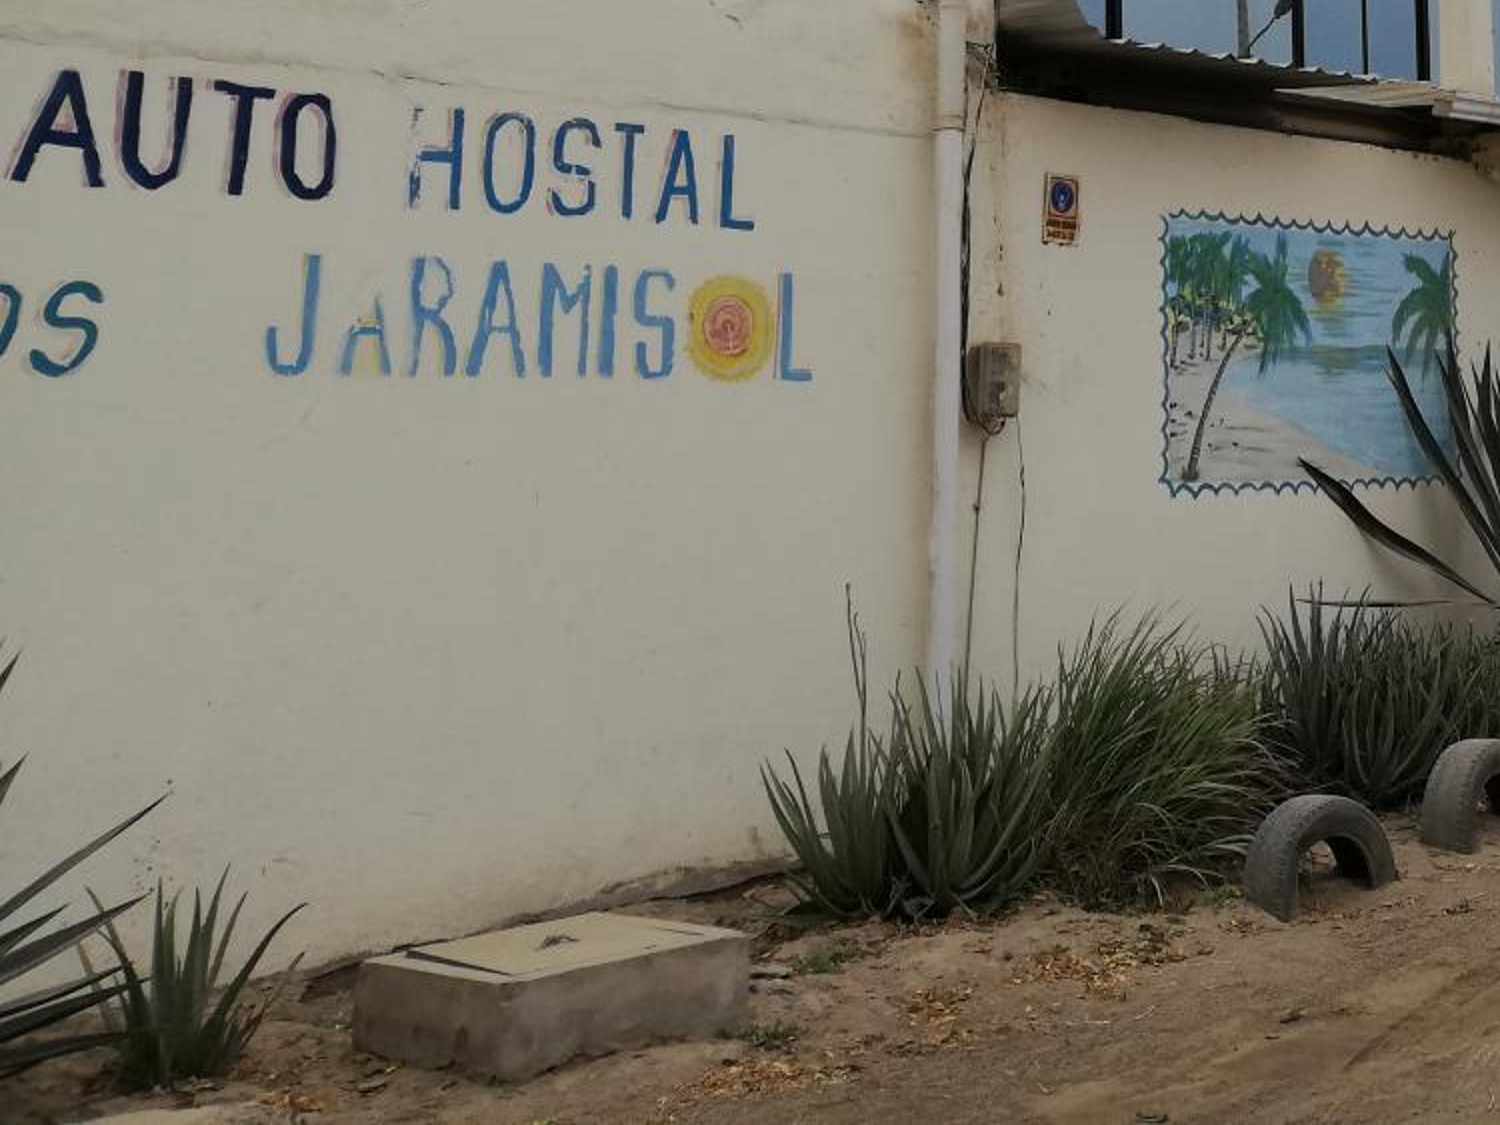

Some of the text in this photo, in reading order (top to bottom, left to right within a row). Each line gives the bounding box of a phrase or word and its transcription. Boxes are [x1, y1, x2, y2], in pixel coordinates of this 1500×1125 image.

[9, 69, 755, 231] AUTO HOSTAL
[265, 252, 813, 384] JARAMISOL
